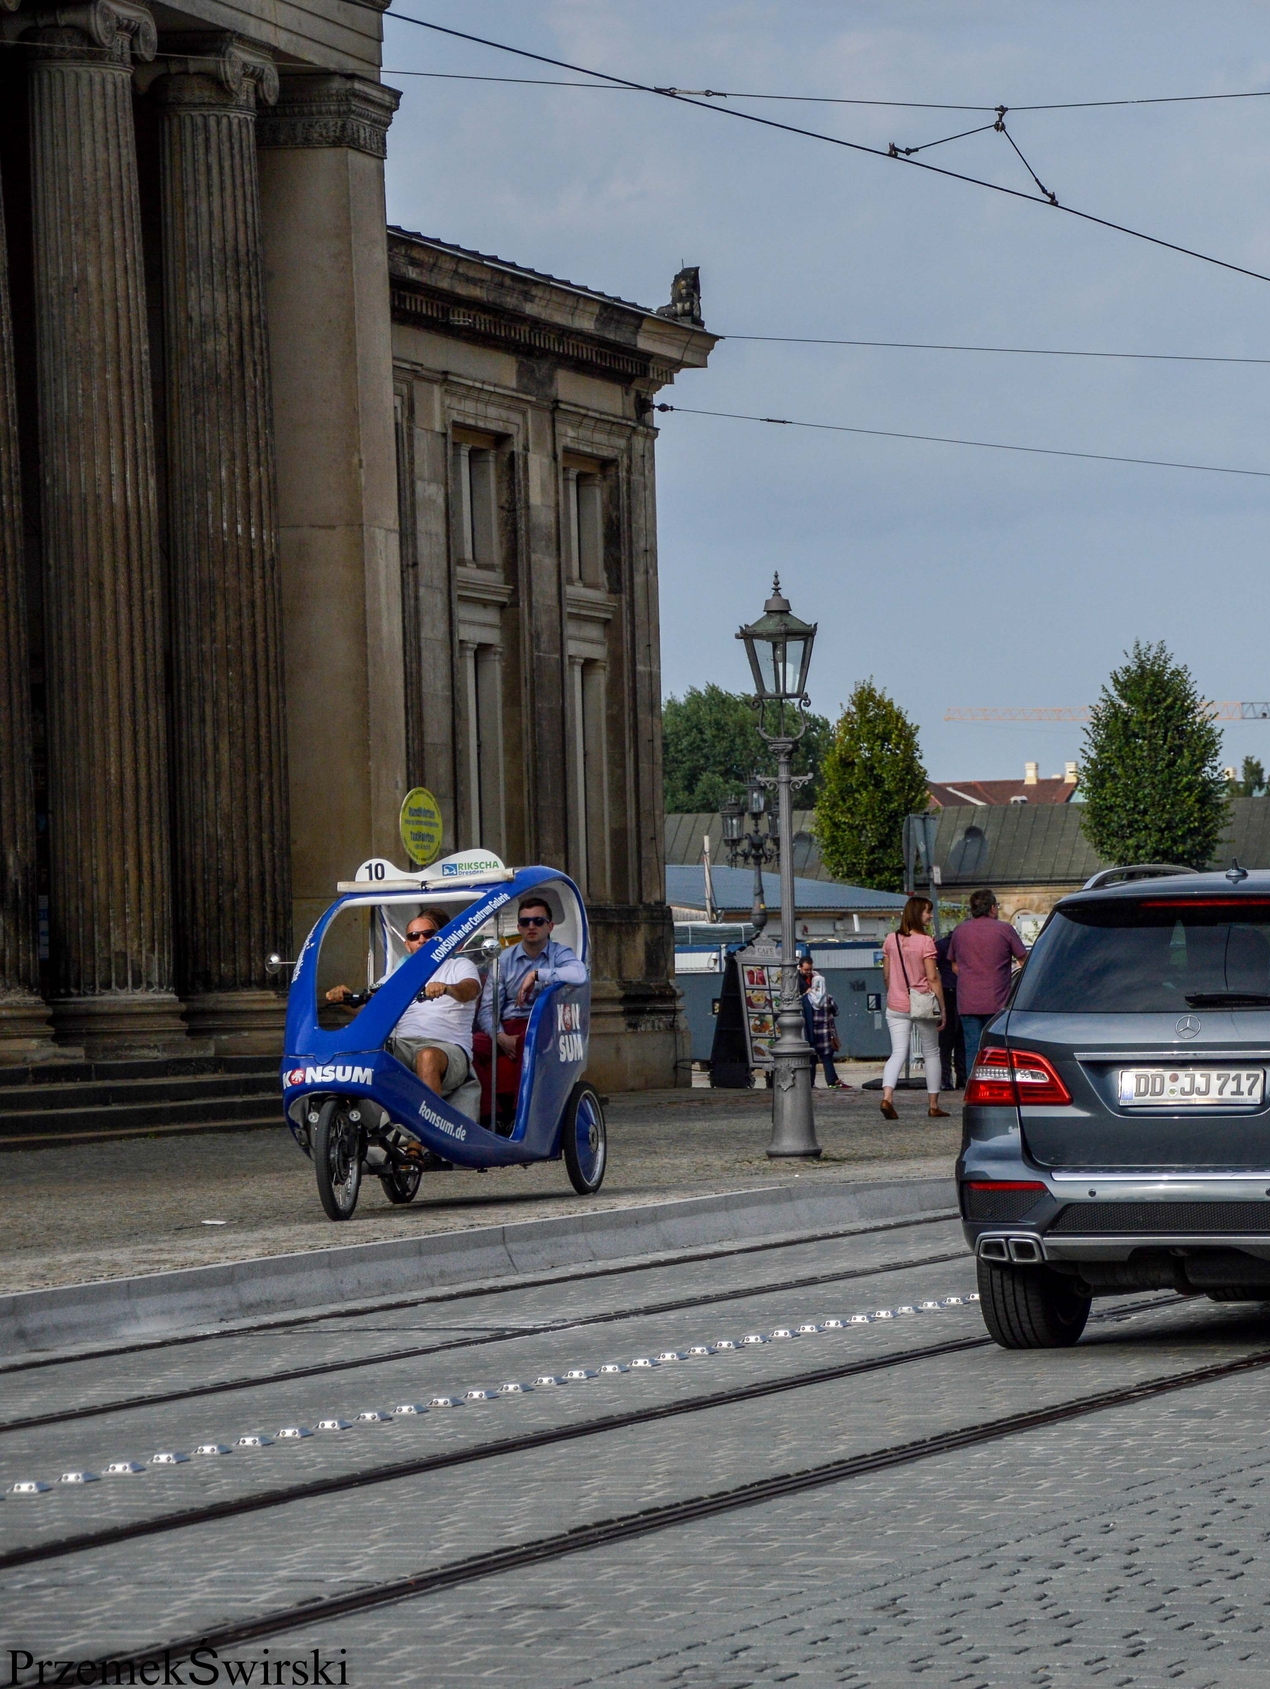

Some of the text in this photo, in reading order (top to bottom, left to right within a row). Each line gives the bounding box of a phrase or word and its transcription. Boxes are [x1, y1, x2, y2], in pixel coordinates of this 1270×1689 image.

[365, 863, 385, 881] 10
[458, 860, 499, 871] RIKSCHA
[430, 932, 461, 963] KONSUM
[454, 929, 466, 940] in
[460, 921, 474, 934] der
[468, 904, 494, 926] Centrum
[488, 892, 511, 909] Galerie
[558, 1034, 584, 1063] SUM
[282, 1065, 373, 1090] KONSUM
[1134, 1073, 1260, 1097] DD JJ 717
[418, 1100, 467, 1142] konsum.de
